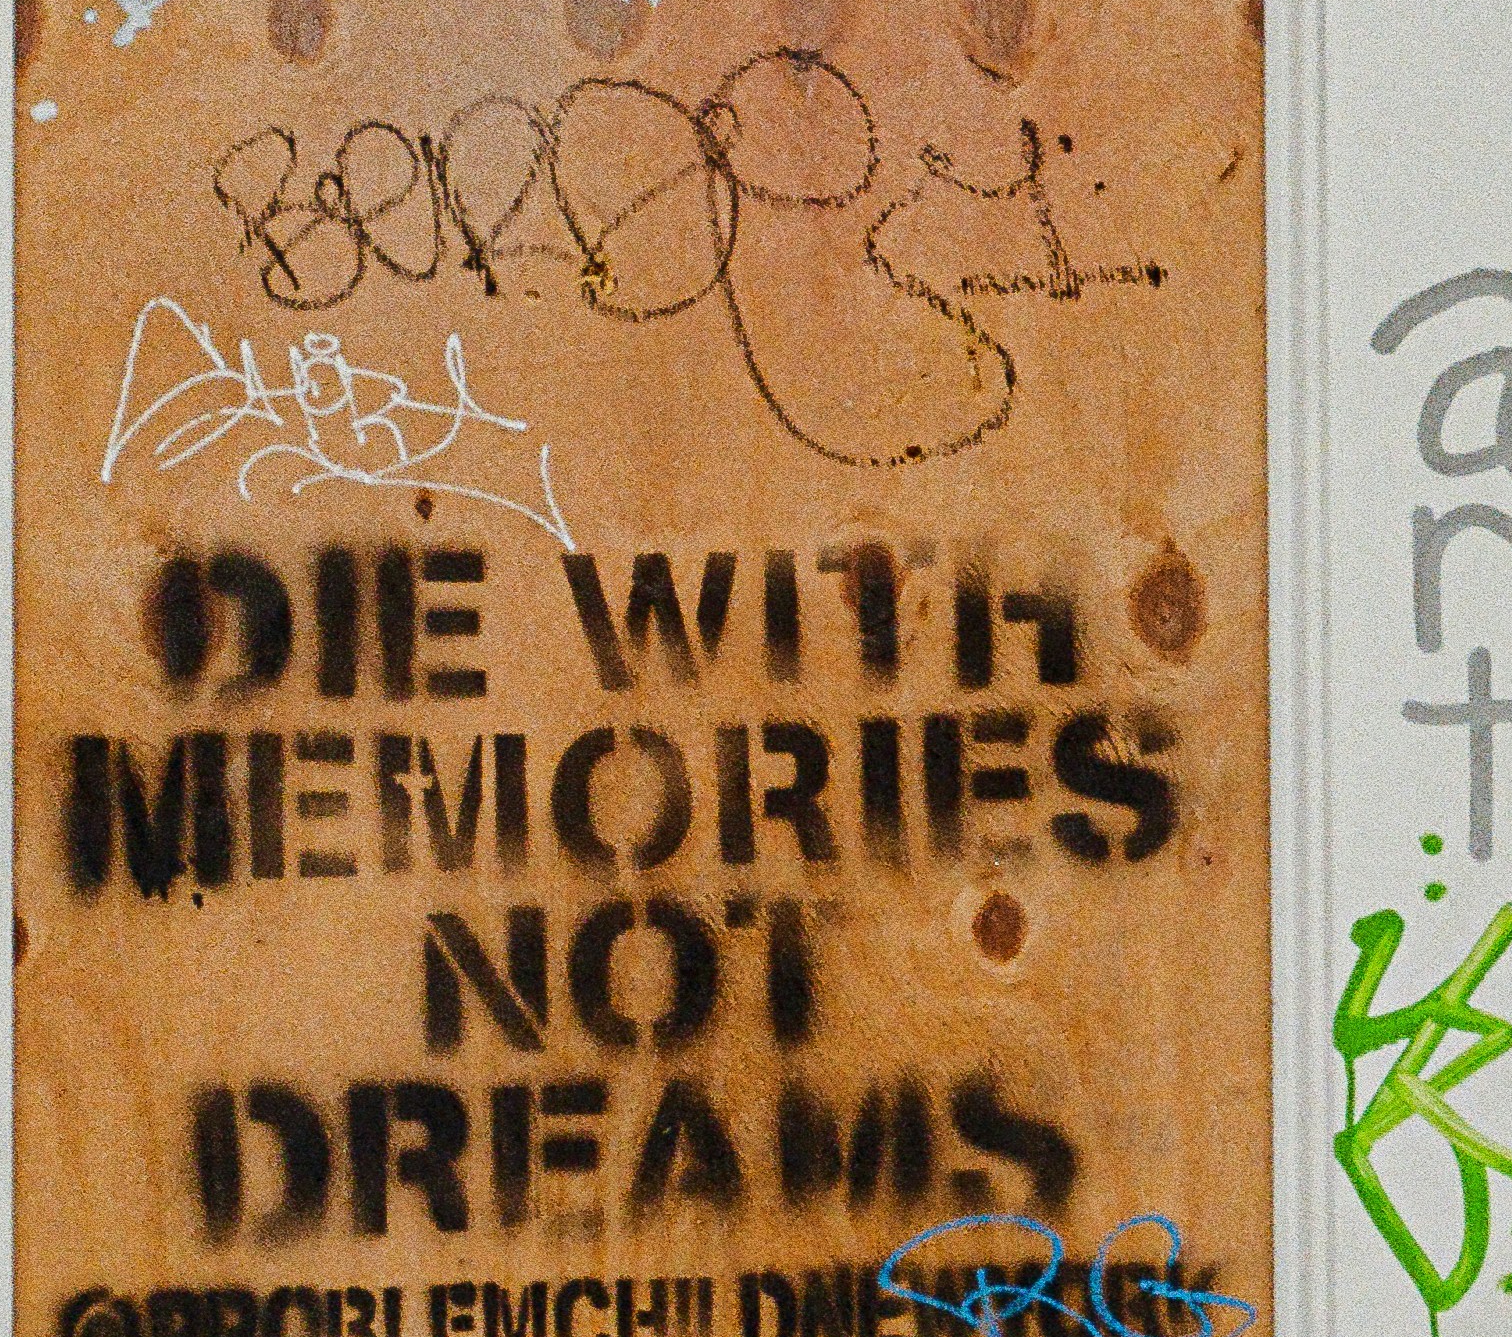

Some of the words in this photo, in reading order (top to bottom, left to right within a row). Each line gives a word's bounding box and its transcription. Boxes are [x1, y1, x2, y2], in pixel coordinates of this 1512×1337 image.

[156, 543, 488, 701] DIE
[560, 543, 1086, 691] WITH
[66, 709, 1180, 893] MEMORIES
[420, 891, 830, 1055] NOT
[192, 1073, 1082, 1245] DREAMS
